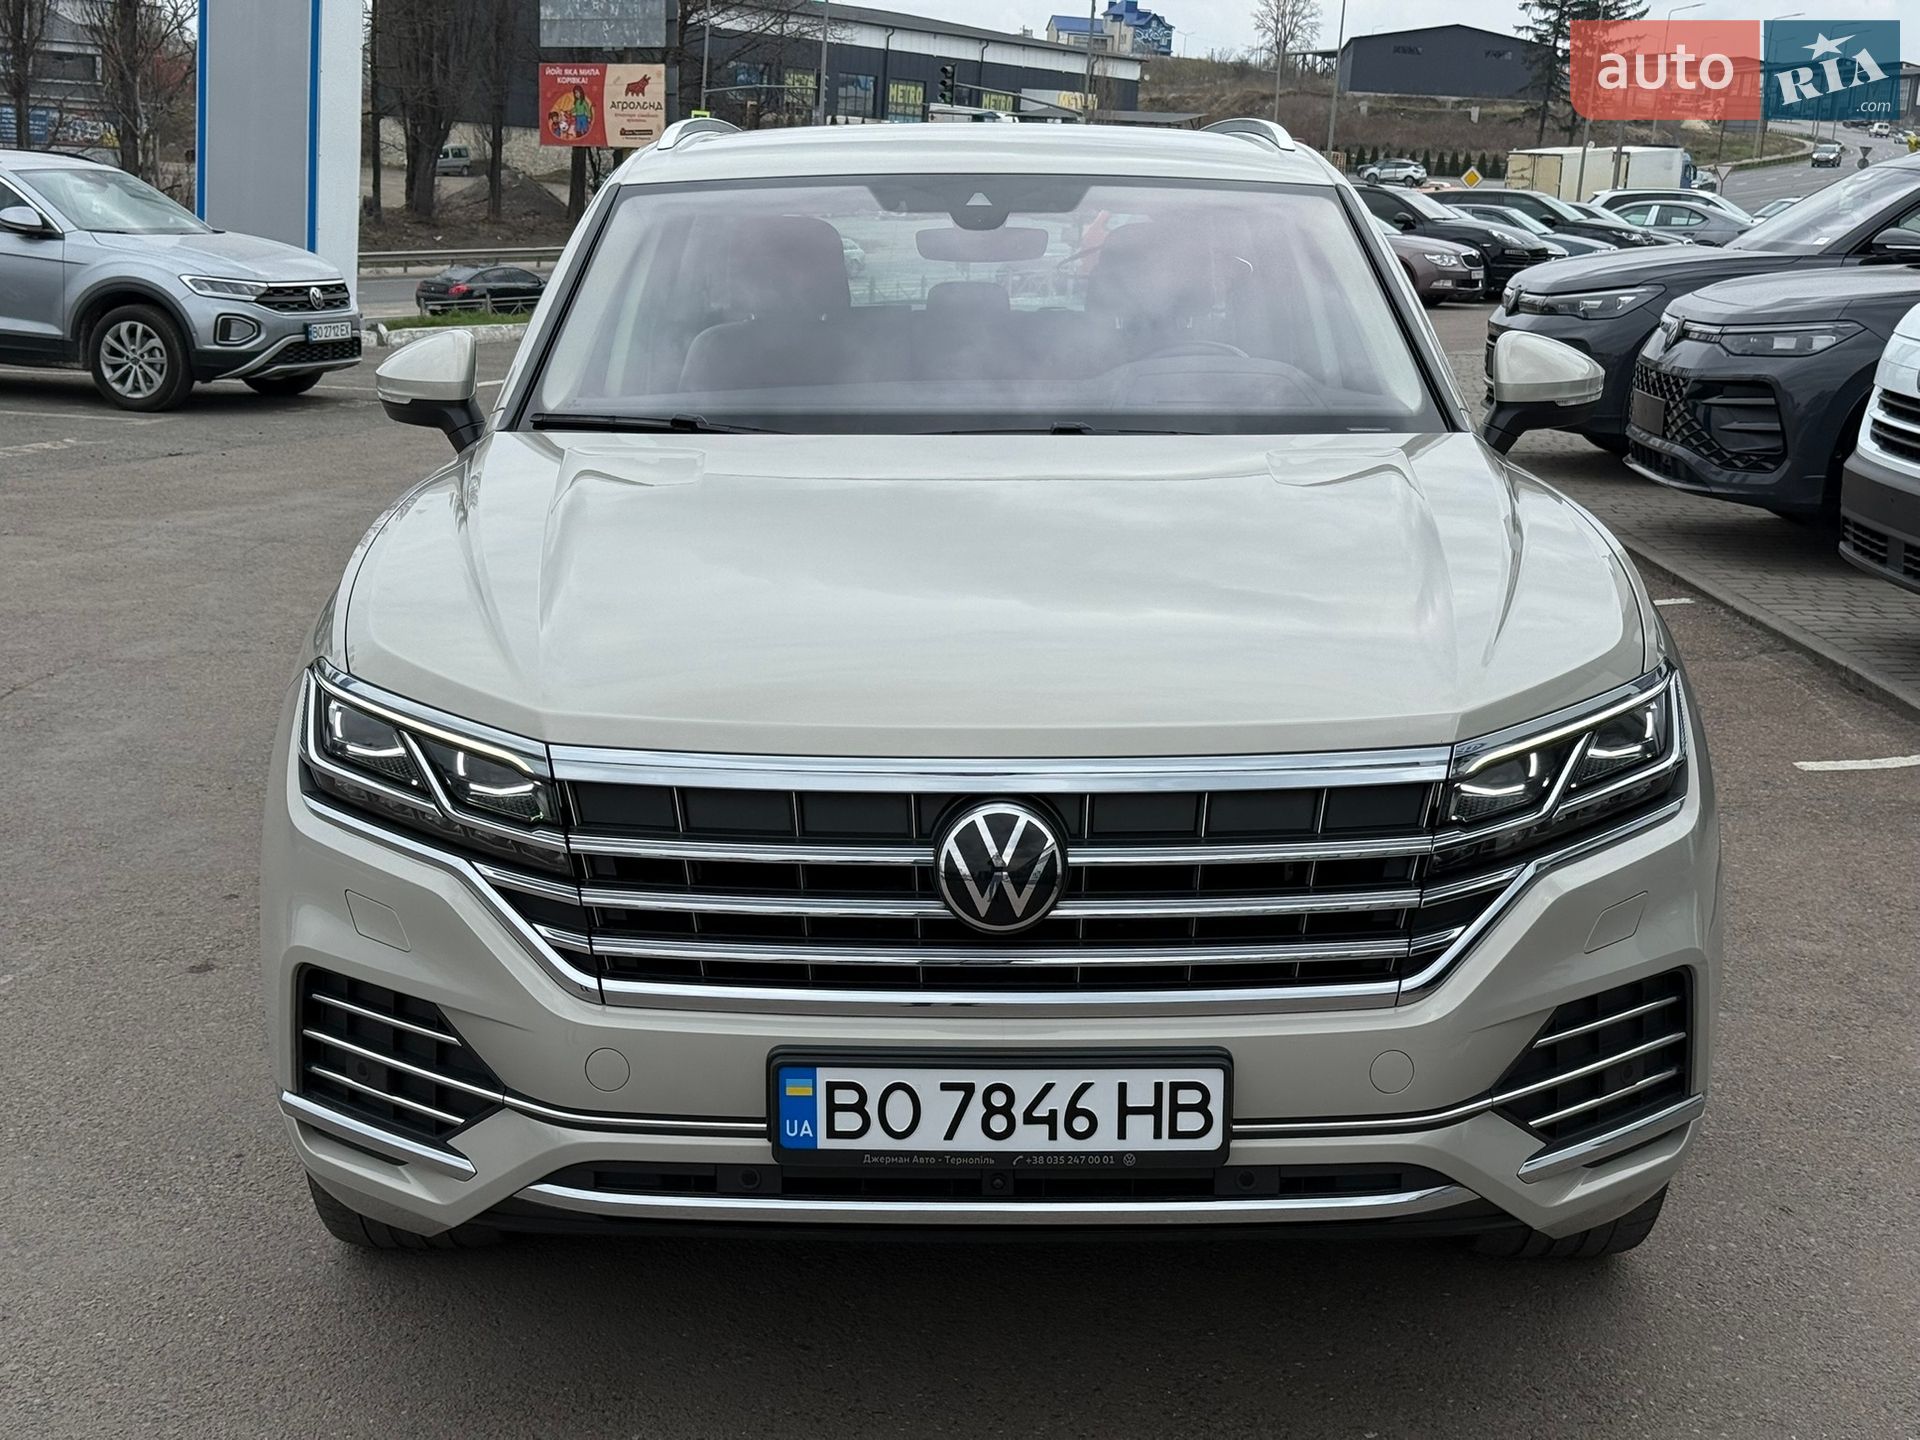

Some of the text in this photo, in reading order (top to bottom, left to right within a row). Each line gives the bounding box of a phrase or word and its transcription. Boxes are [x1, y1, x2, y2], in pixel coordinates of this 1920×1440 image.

[889, 83, 923, 105] METRO
[826, 1080, 1213, 1141] BO 7846 HB
[785, 1119, 813, 1138] UA
[863, 1154, 909, 1165] Джерман
[912, 1155, 935, 1164] Авто
[944, 1156, 995, 1165] Тернопіль
[1025, 1155, 1115, 1165] +38 035 247 00 01
